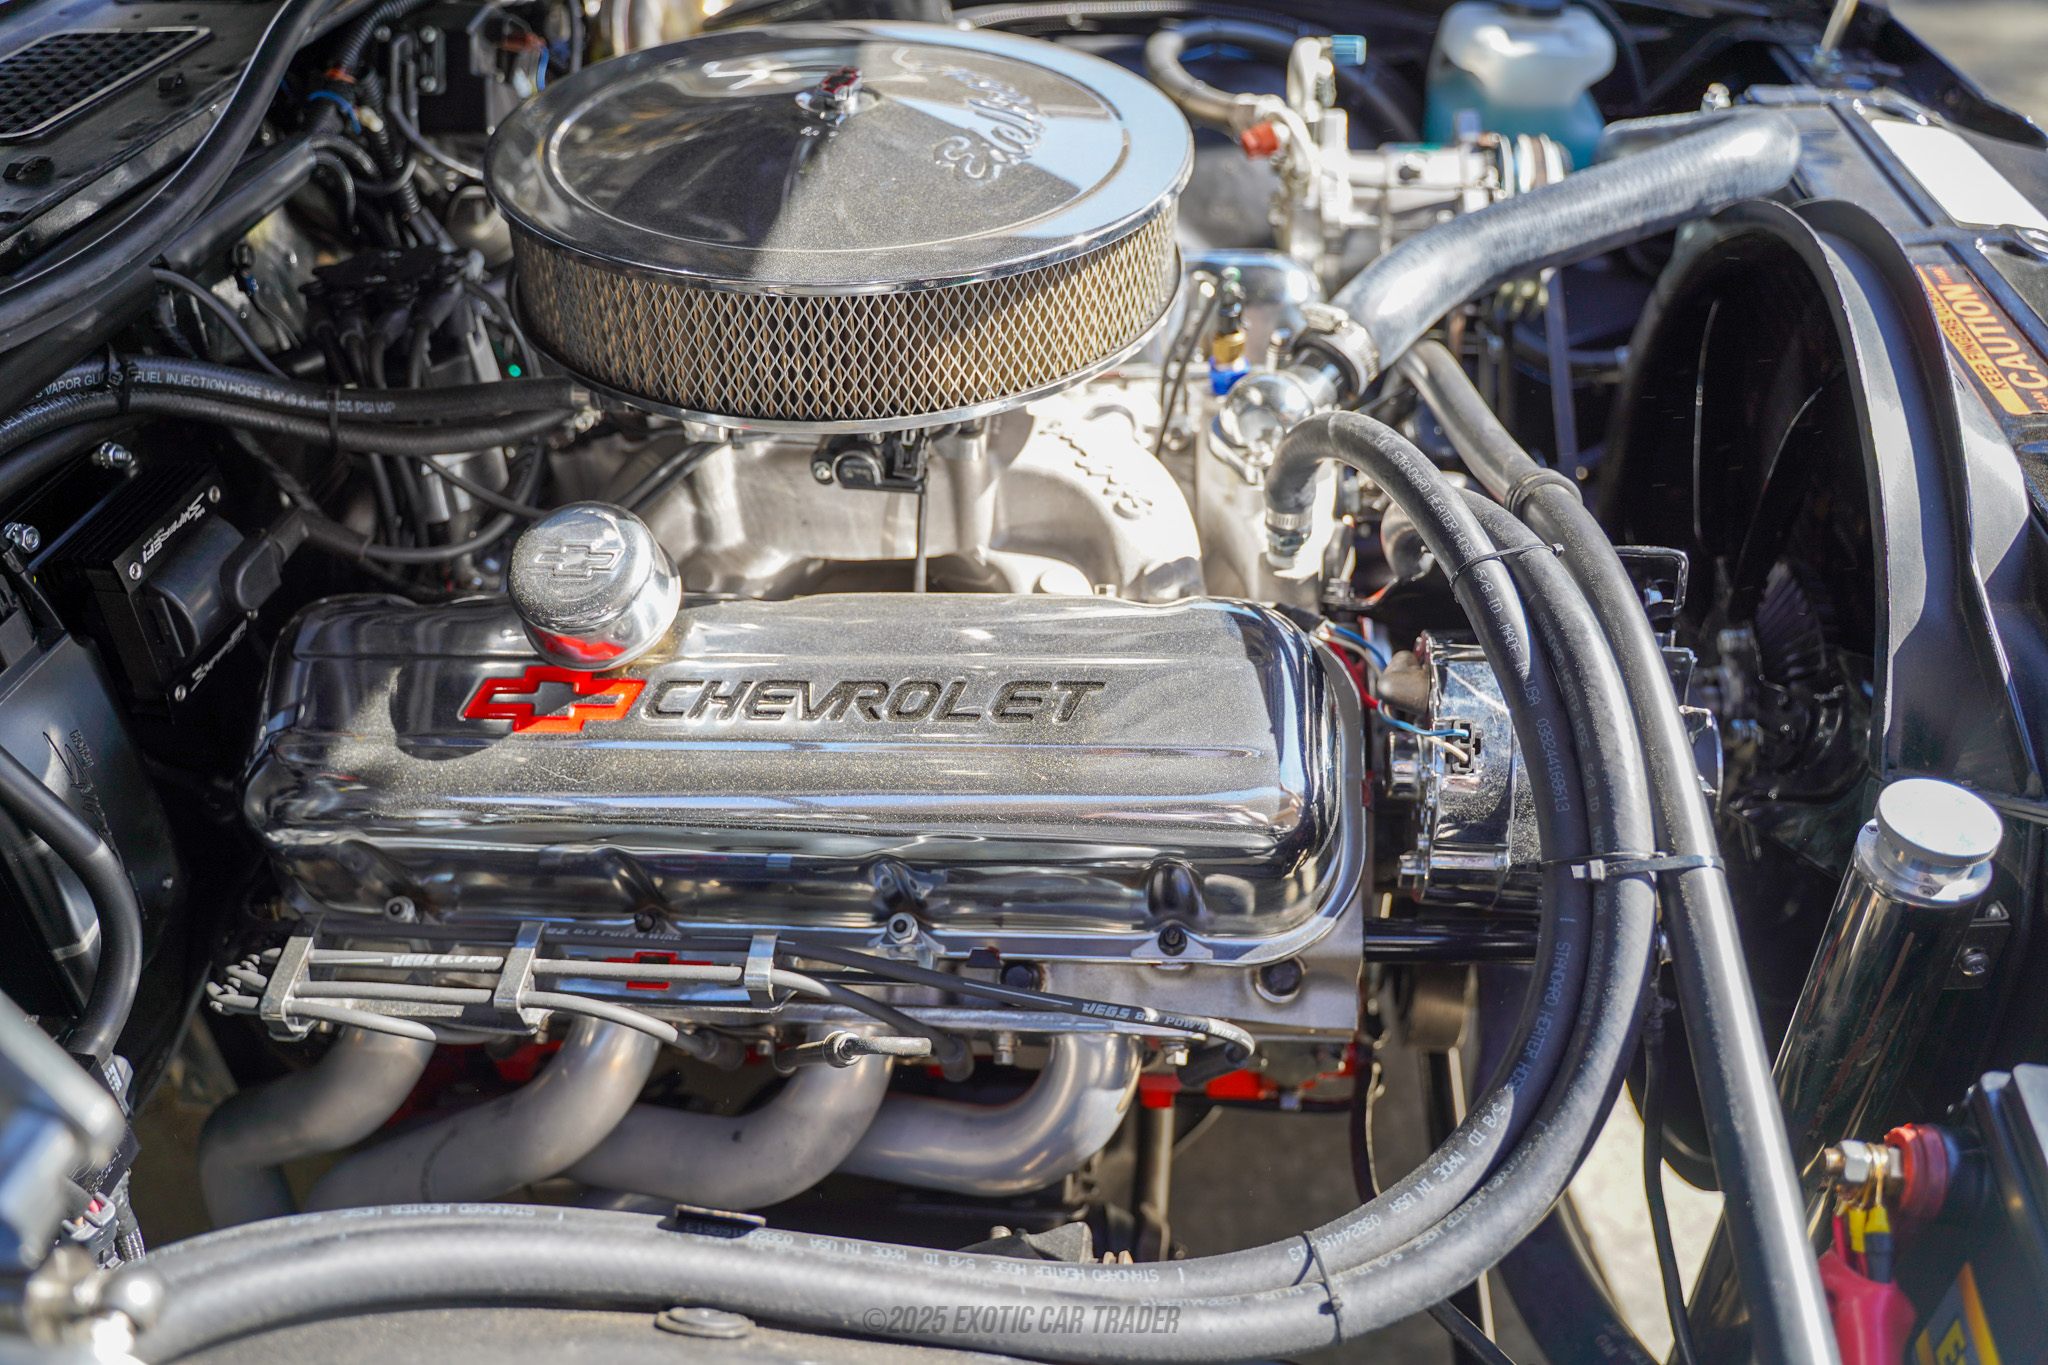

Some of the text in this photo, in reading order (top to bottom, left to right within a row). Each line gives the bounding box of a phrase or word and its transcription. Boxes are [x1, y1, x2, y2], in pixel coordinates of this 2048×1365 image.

[1937, 283, 2048, 389] CAUTION
[45, 375, 82, 395] VAPOR
[134, 371, 163, 384] FUEL
[165, 372, 228, 393] INJECTION
[229, 381, 263, 400] HOSE
[1975, 364, 2011, 391] KEEP
[0, 415, 23, 433] UEL
[1391, 451, 1431, 493] STANDARD
[1426, 492, 1459, 531] HEATER
[1475, 568, 1495, 594] 5/8
[1499, 623, 1523, 655] MADE
[1523, 680, 1541, 707] USA
[643, 678, 1106, 723] CHEVROLET
[1543, 941, 1571, 1006] STANDARD
[1523, 1009, 1554, 1060] HEATER
[1482, 1102, 1506, 1129] 5/8
[1468, 1128, 1487, 1147] ID
[1433, 1150, 1466, 1182] MADE
[1414, 1178, 1435, 1198] IN
[1388, 1192, 1417, 1214] USA
[808, 1236, 840, 1252] USA
[843, 1241, 863, 1255] IN
[871, 1245, 908, 1261] MADE
[922, 1250, 941, 1267] ID
[947, 1254, 977, 1271] 5/8
[991, 1259, 1028, 1277] HOSE
[1034, 1264, 1087, 1282] HEATER
[1092, 1268, 1161, 1284] STANDARD
